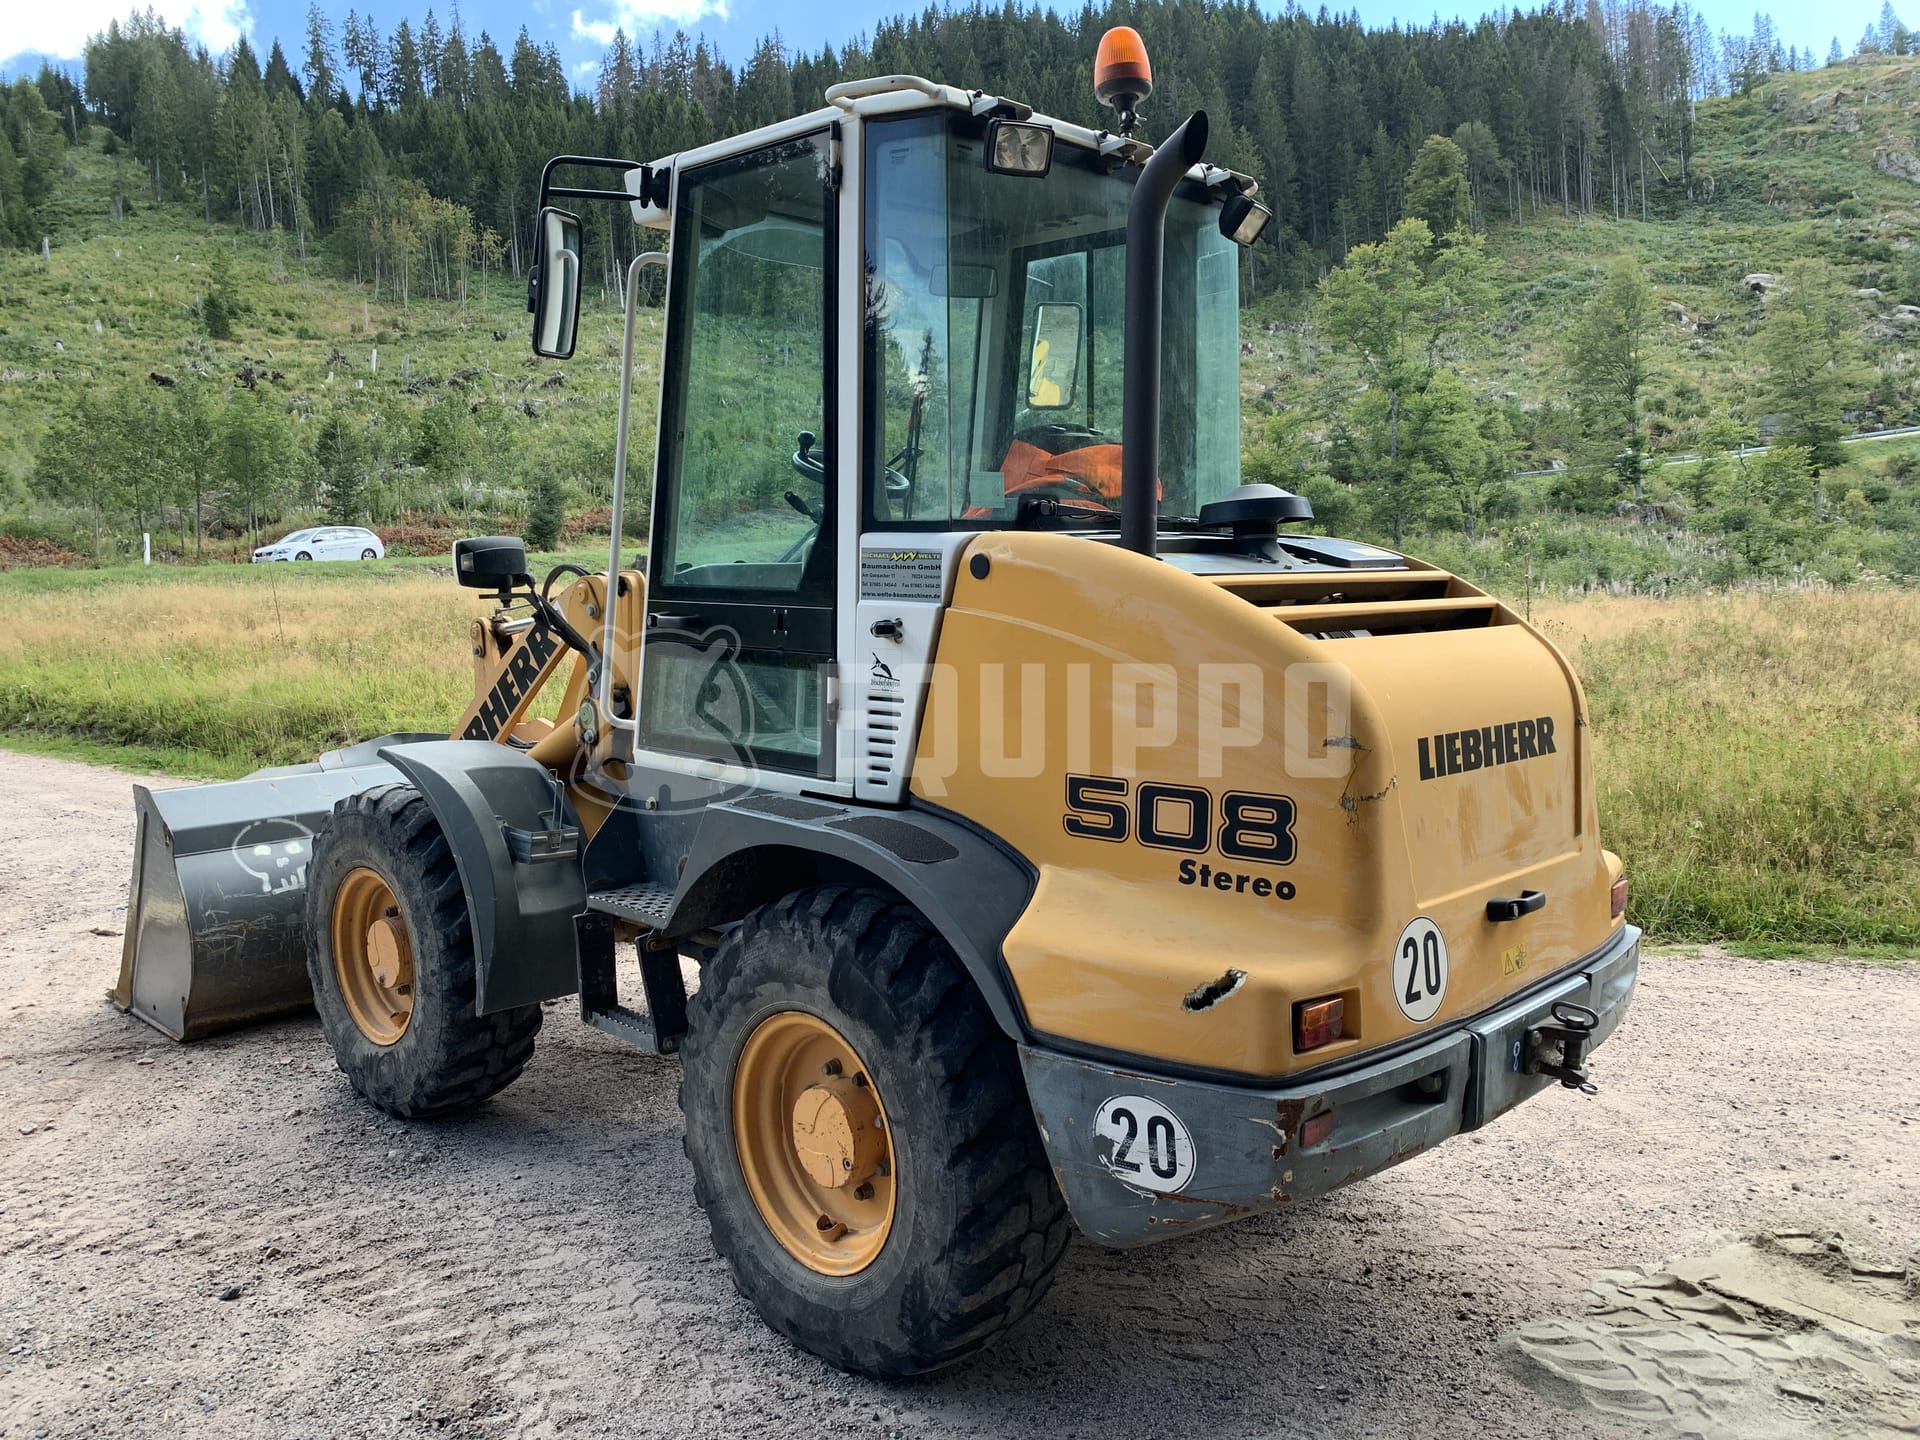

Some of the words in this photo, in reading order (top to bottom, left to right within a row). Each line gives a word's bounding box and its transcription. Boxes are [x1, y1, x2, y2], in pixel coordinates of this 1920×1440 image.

[460, 609, 558, 741] BHERR
[1417, 716, 1556, 781] LIEBHERR
[1063, 773, 1297, 866] 508
[1178, 859, 1296, 900] Stereo
[1402, 930, 1441, 1005] 20
[1111, 1107, 1178, 1179] 20
